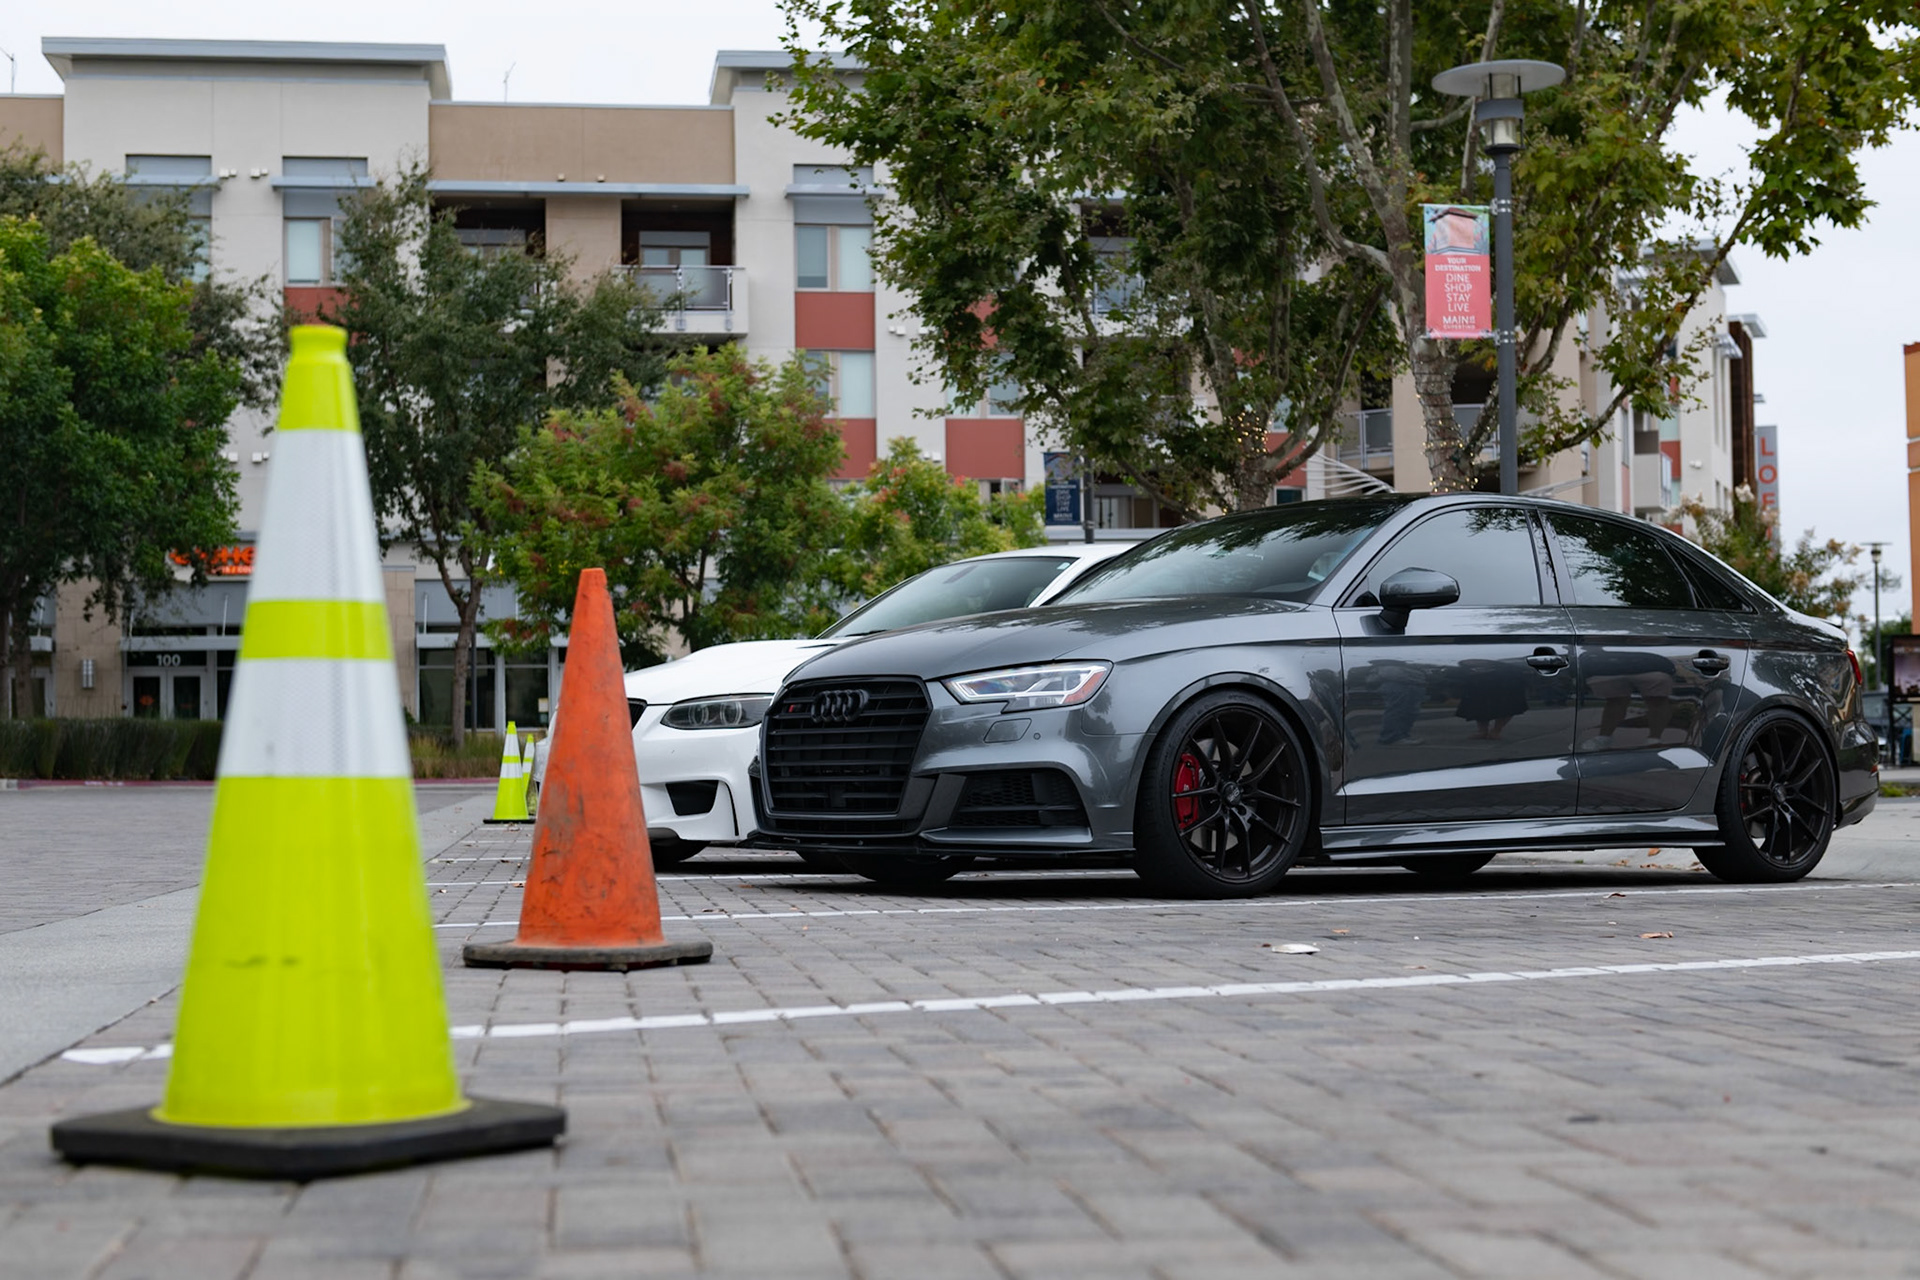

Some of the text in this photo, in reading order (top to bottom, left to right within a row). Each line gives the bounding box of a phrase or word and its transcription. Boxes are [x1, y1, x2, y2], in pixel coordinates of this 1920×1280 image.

[1434, 264, 1481, 272] DESTINATION
[1446, 273, 1470, 282] DINE
[1444, 283, 1472, 292] SHOP
[1446, 293, 1471, 302] STAY
[1448, 303, 1469, 312] LIVE
[156, 654, 181, 667] 100
